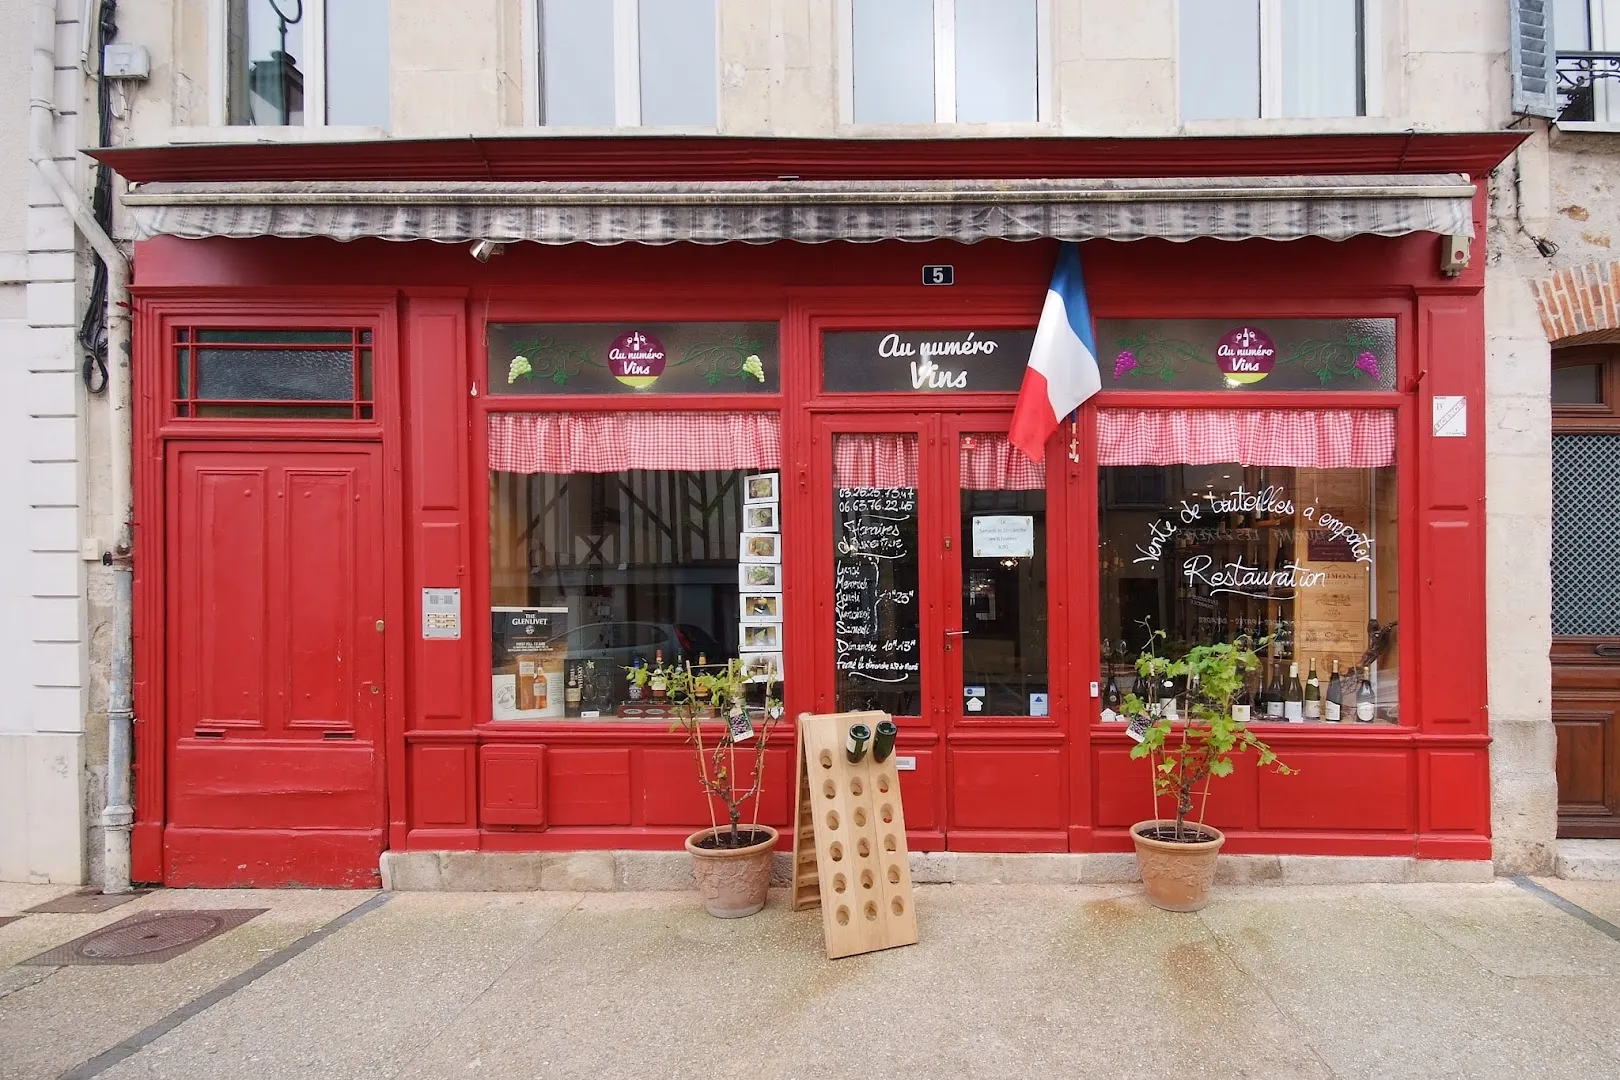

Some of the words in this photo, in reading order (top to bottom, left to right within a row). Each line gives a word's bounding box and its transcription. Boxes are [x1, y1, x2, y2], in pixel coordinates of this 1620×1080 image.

[933, 267, 944, 283] 5
[878, 333, 915, 358] Au
[920, 332, 998, 356] numéro
[1217, 345, 1235, 356] Au
[1236, 344, 1274, 357] numéro
[609, 348, 627, 360] Au
[628, 347, 664, 360] numéro
[622, 361, 650, 375] Vins
[1231, 357, 1260, 371] Vins
[910, 361, 967, 389] Vins
[1132, 518, 1177, 564] Vente
[1180, 500, 1202, 524] de
[1302, 497, 1319, 521] à
[1318, 513, 1375, 563] emporter
[1183, 554, 1326, 589] Restauration
[512, 618, 548, 626] GLENLIVET
